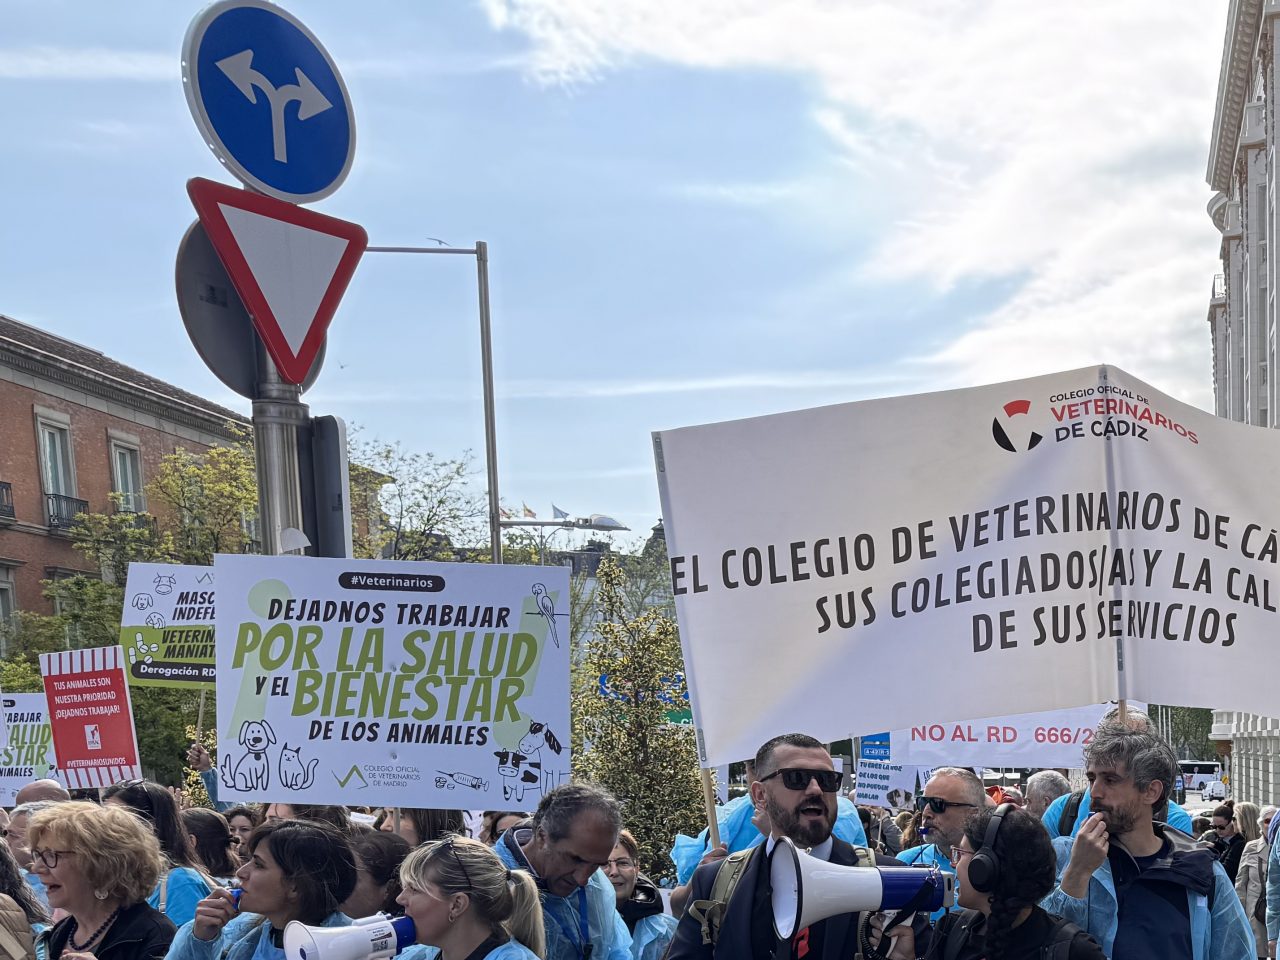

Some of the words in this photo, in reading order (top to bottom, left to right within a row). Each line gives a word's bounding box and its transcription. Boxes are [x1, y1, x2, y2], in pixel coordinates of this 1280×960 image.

[1050, 388, 1095, 403] COLEGIO
[1097, 386, 1135, 400] OFICIAL
[1137, 394, 1150, 406] DE
[1051, 398, 1199, 445] VETERINARIOS
[1055, 422, 1085, 443] DE
[1090, 416, 1149, 442] CÁDIZ
[670, 555, 709, 596] EL
[722, 534, 875, 590] COLEGIO
[892, 520, 937, 564] DE
[948, 490, 1181, 553] VETERINARIOS
[1194, 507, 1230, 550] DE
[350, 576, 433, 589] #Veterinarios
[815, 586, 877, 634] SUS
[891, 544, 1135, 618] COLEGIADOS/AS
[1143, 549, 1163, 588] Y
[1172, 552, 1212, 594] LA
[268, 599, 386, 624] DEJADNOS
[397, 604, 511, 628] TRABAJAR
[972, 610, 1018, 653] DE
[1033, 602, 1086, 653] SUS
[1097, 600, 1238, 648] SERVICIOS
[232, 622, 324, 672] POR
[336, 627, 385, 673] LA
[400, 630, 538, 678] SALUD
[54, 681, 66, 690] TUS
[66, 678, 97, 689] ANIMALES
[98, 678, 111, 686] SON
[140, 665, 199, 677] Derogación
[202, 668, 216, 676] RD
[55, 694, 82, 704] NUESTRA
[82, 691, 116, 701] PRIORIDAD
[256, 676, 267, 695] Y
[271, 676, 289, 696] EL
[291, 670, 526, 723] BIENESTAR
[56, 707, 88, 720] ¡DEJADNOS
[88, 704, 120, 716] TRABAJAR!
[309, 720, 335, 741] DE
[341, 722, 380, 742] LOS
[387, 724, 489, 747] ANIMALES
[912, 724, 945, 742] NO
[951, 724, 979, 742] AL
[987, 726, 1018, 743] RD
